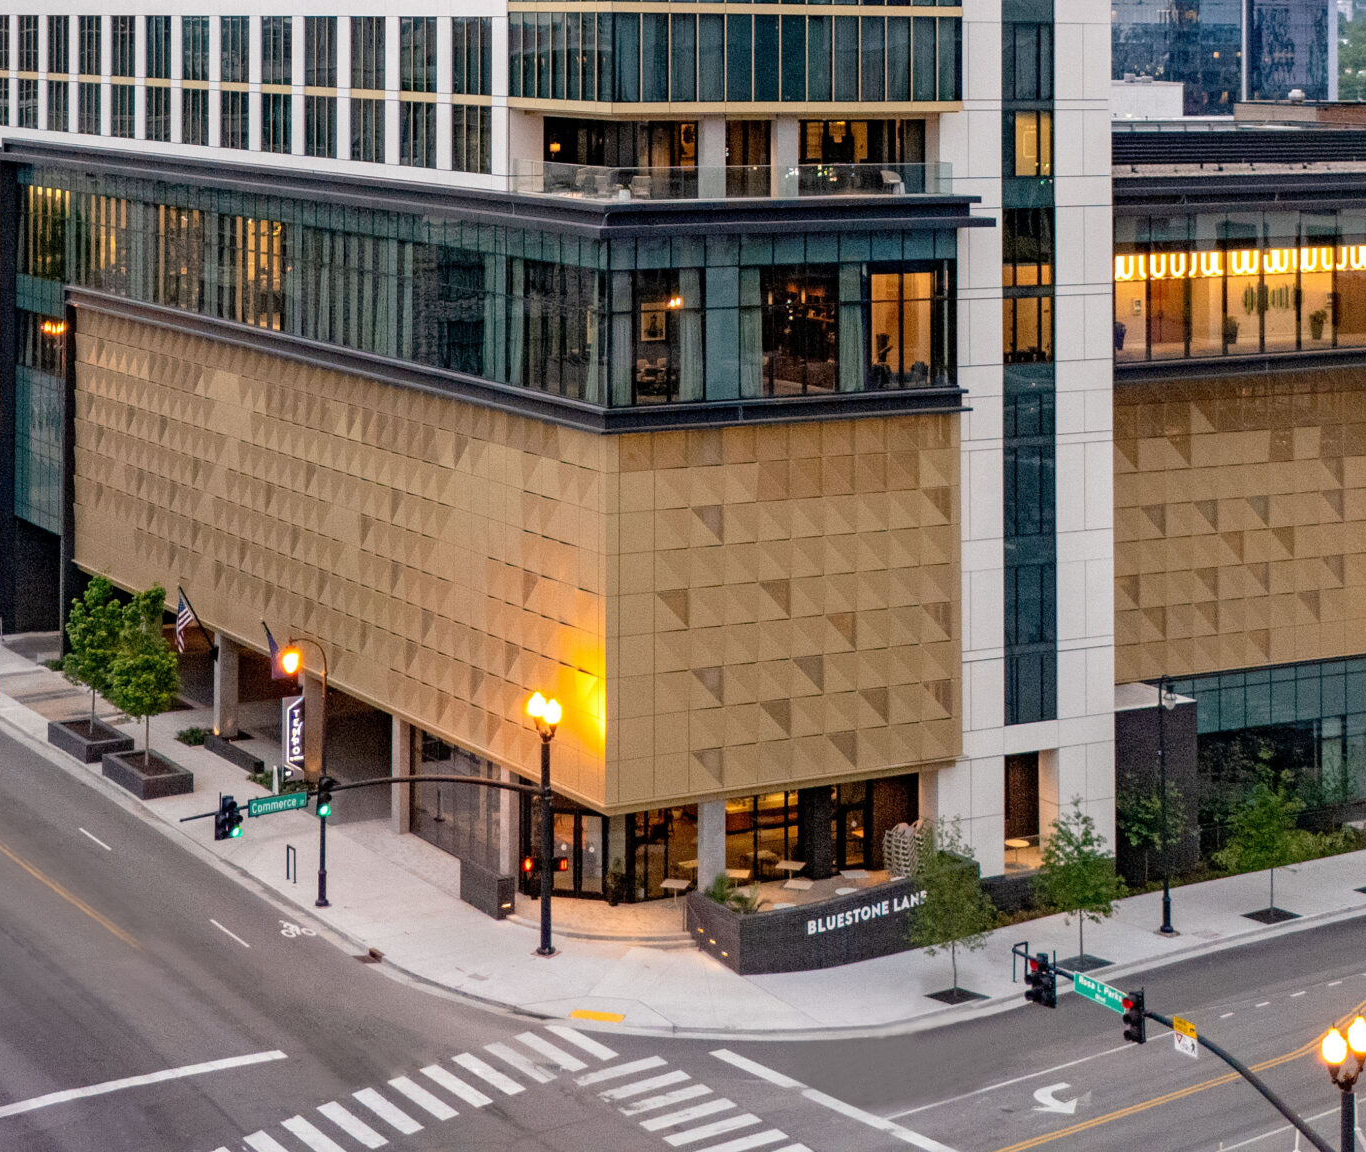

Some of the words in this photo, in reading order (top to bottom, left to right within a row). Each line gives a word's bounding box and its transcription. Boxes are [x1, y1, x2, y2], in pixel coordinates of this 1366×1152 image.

[291, 709, 301, 755] TEMPO
[251, 798, 296, 814] Commerce
[807, 900, 889, 935] BLUESTONE
